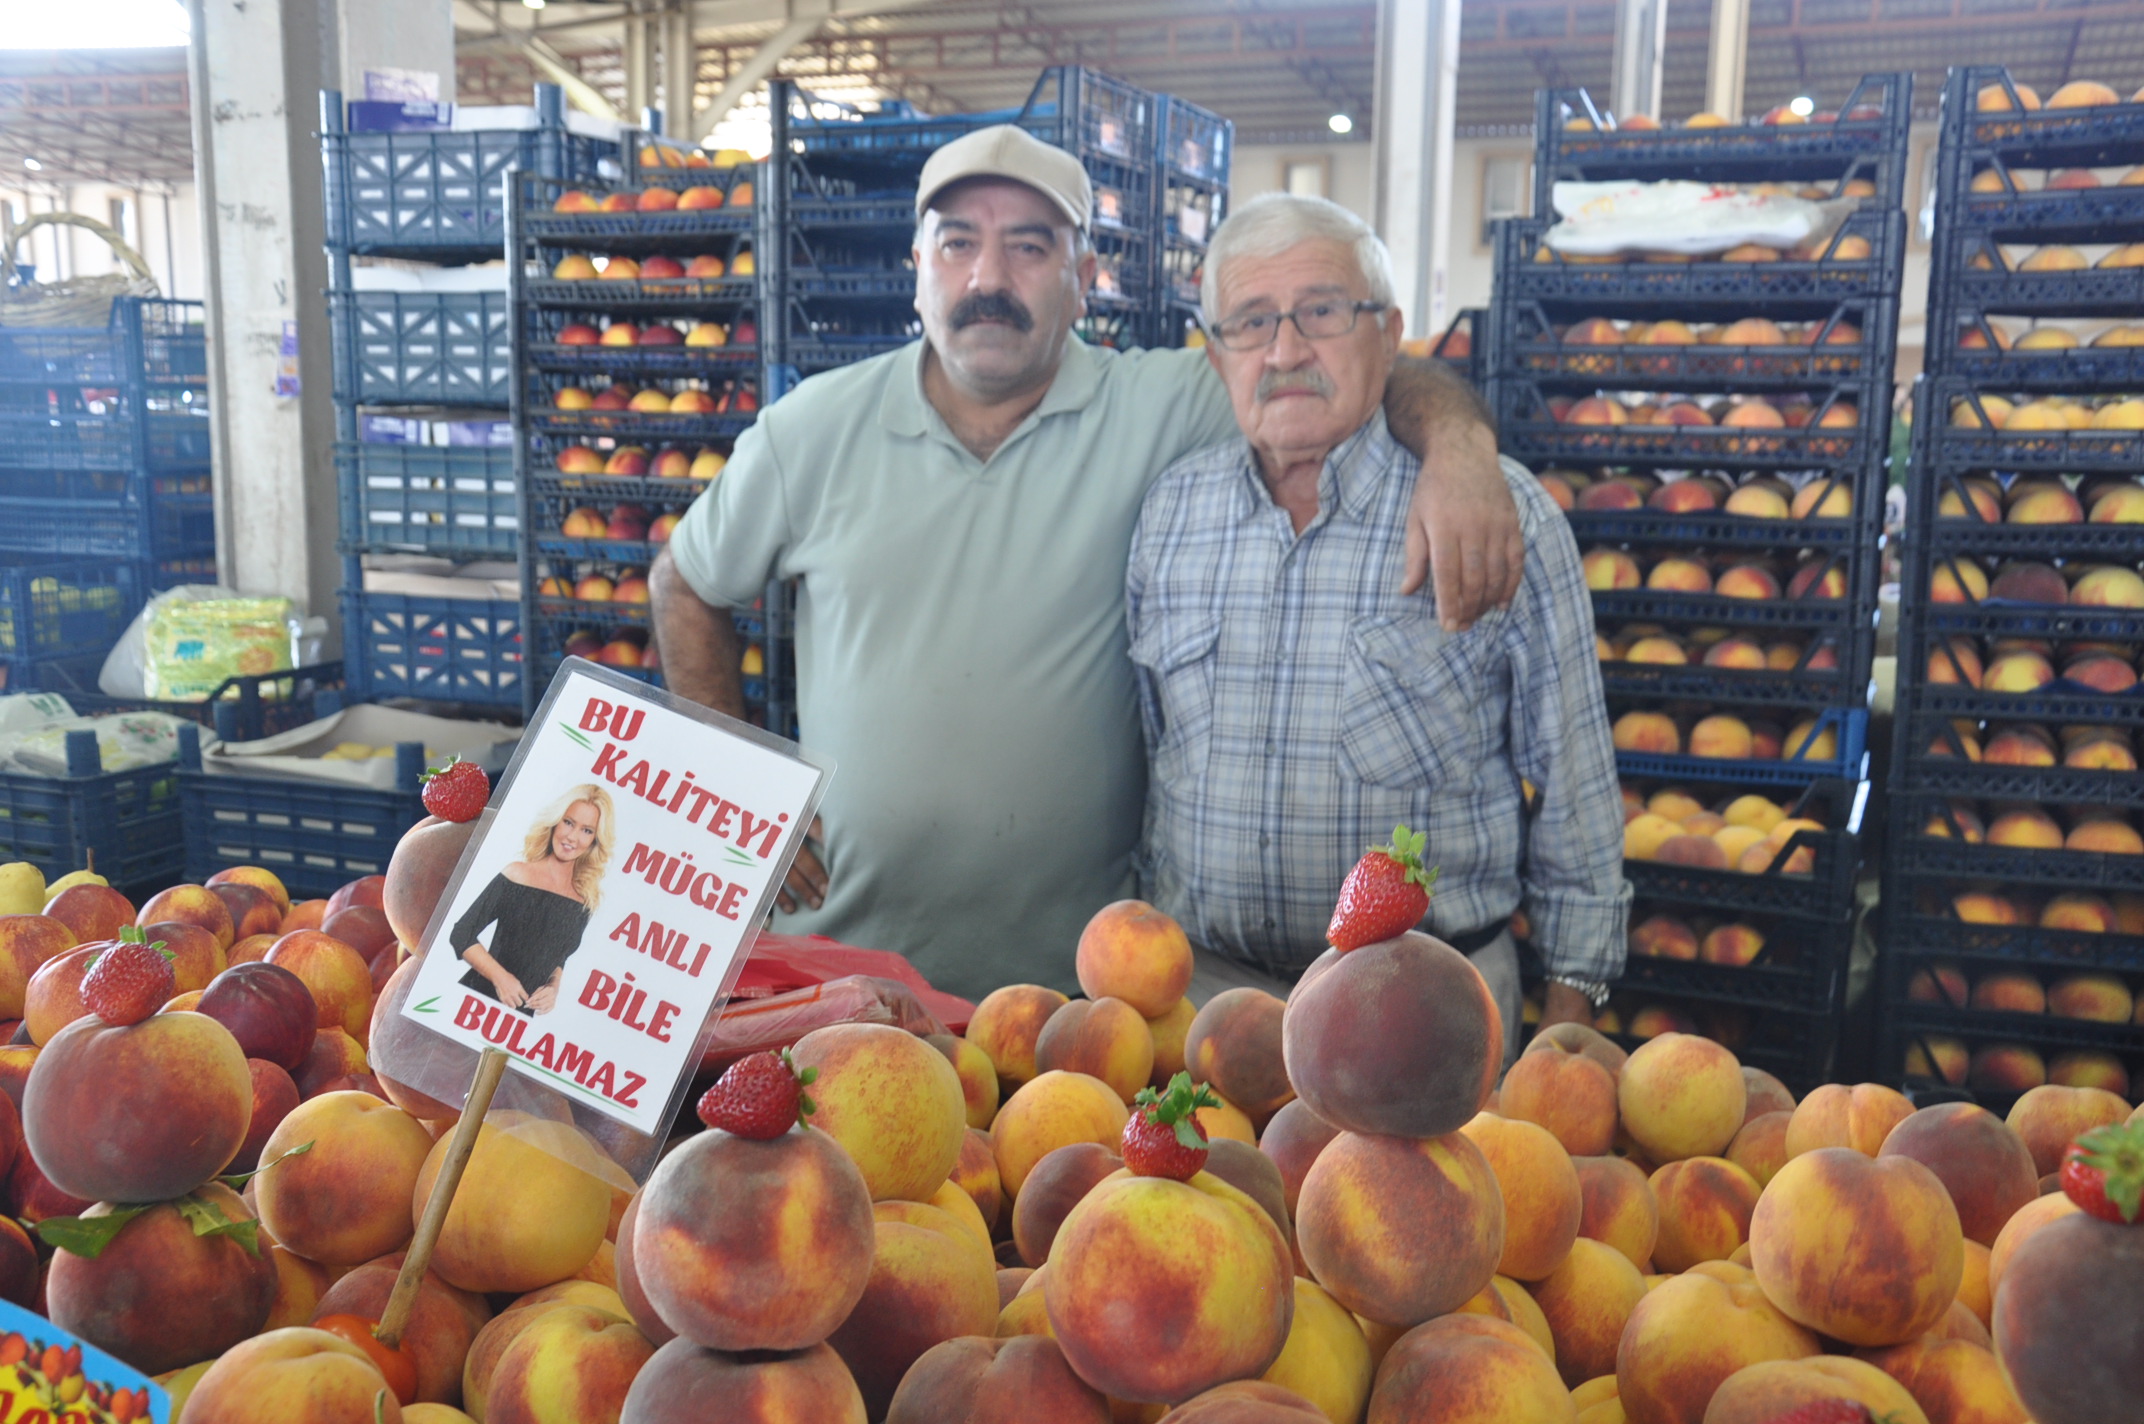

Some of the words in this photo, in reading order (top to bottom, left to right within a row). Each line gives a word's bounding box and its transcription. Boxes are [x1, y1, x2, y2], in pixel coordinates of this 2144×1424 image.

[579, 698, 646, 741] BU
[591, 742, 788, 859] KALİTEYİ
[622, 842, 749, 921] MÜGE
[609, 912, 712, 977] ANLI
[577, 970, 681, 1044] BİLE
[453, 994, 647, 1109] BULAMAZ
